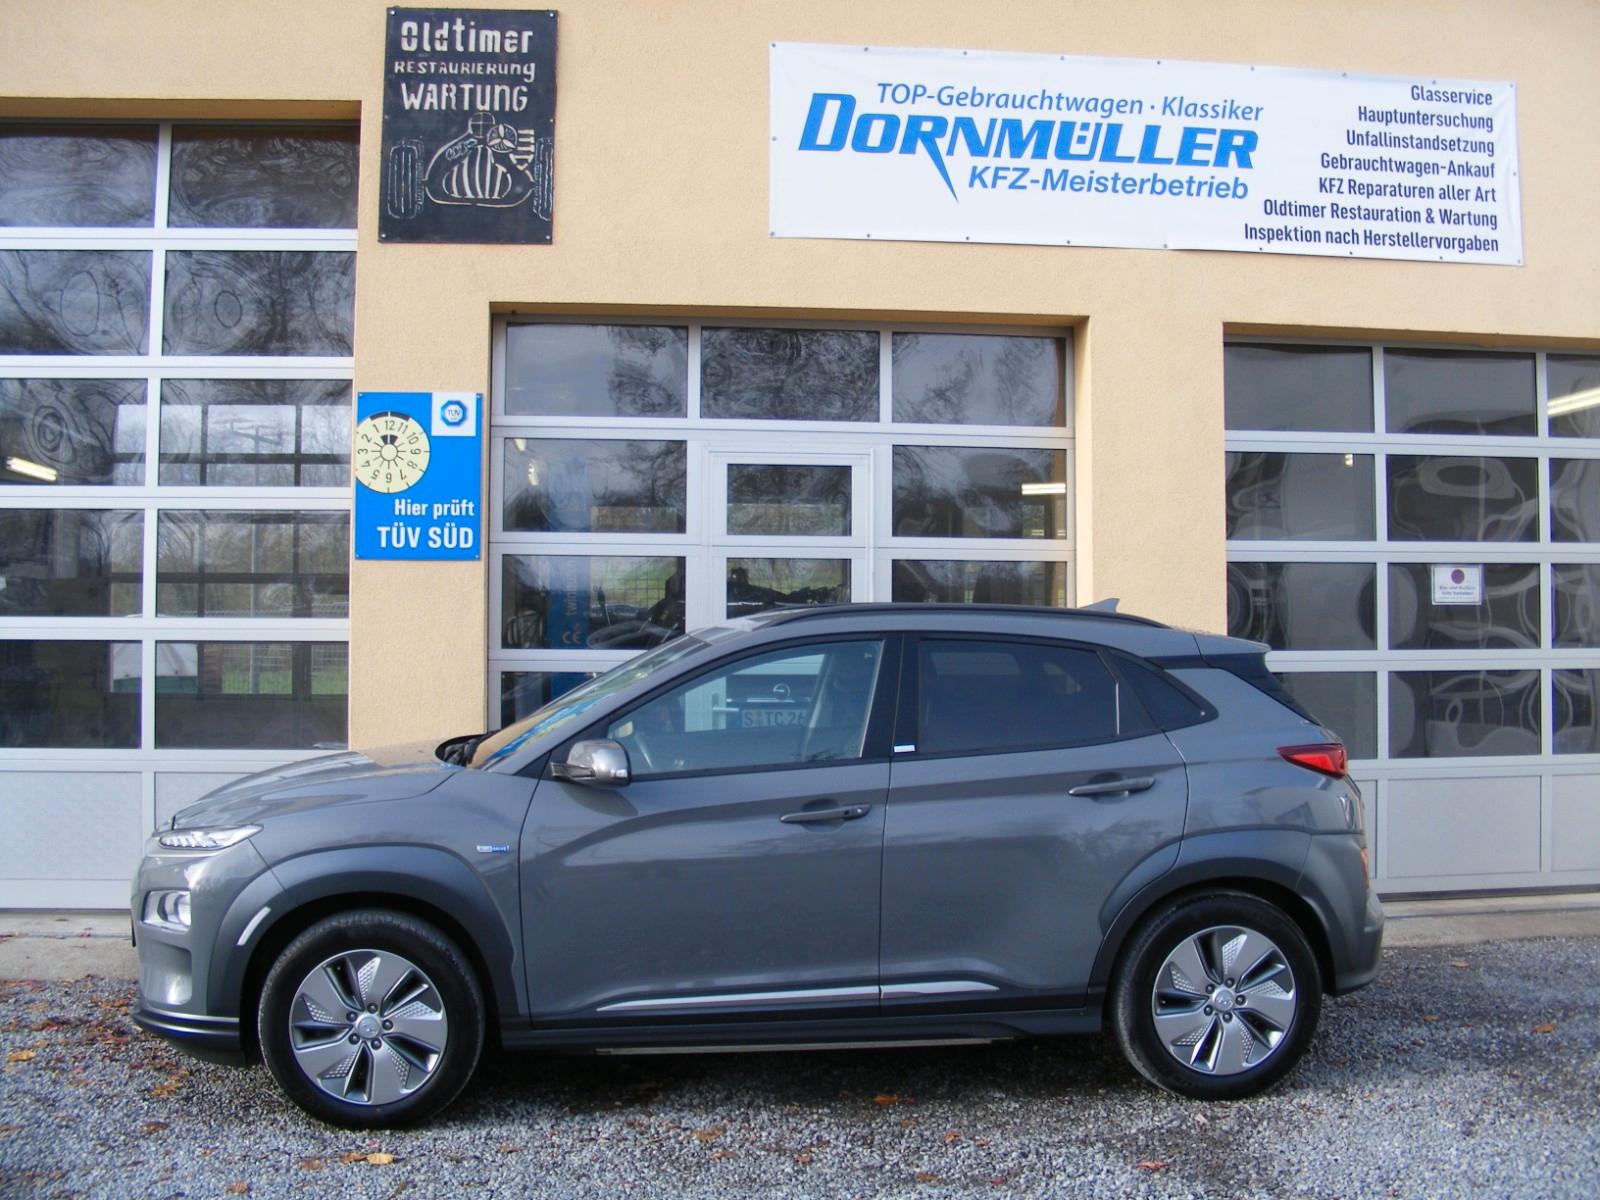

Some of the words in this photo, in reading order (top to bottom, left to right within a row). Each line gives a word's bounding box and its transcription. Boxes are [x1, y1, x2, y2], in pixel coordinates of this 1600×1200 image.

[401, 17, 534, 53] Oldtimer
[877, 82, 1143, 118] TOP-Gebrauchtwagen
[1162, 96, 1264, 121] Klassiker
[1411, 85, 1493, 106] Glasservice
[1358, 106, 1494, 133] Hauptuntersuchung
[1346, 129, 1495, 157] Unfallinstandsetzung
[1320, 152, 1495, 179] Gebrauchtwagen-Ankauf
[968, 166, 1249, 200] KFZ-Meisterbetrieb
[1319, 177, 1345, 195] KFZ
[1348, 178, 1435, 201] Reparaturen
[1439, 184, 1471, 201] aller
[1475, 186, 1497, 202] Art
[1263, 199, 1327, 218] Oldtimer
[1330, 202, 1421, 224] Restauration
[1425, 207, 1435, 224] &
[1439, 208, 1498, 230] Wartung
[1244, 223, 1321, 245] Inspektion
[1325, 228, 1360, 245] nach
[1363, 229, 1499, 253] Herstellervorgaben
[361, 433, 372, 443] 2
[384, 420, 395, 431] 12
[397, 421, 409, 434] 11
[406, 431, 419, 445] 10
[371, 469, 381, 480] 5
[407, 460, 418, 470] 8
[394, 498, 428, 516] Hier
[433, 499, 475, 520] prüft
[377, 522, 421, 549] TÜV
[428, 522, 473, 549] SÜD
